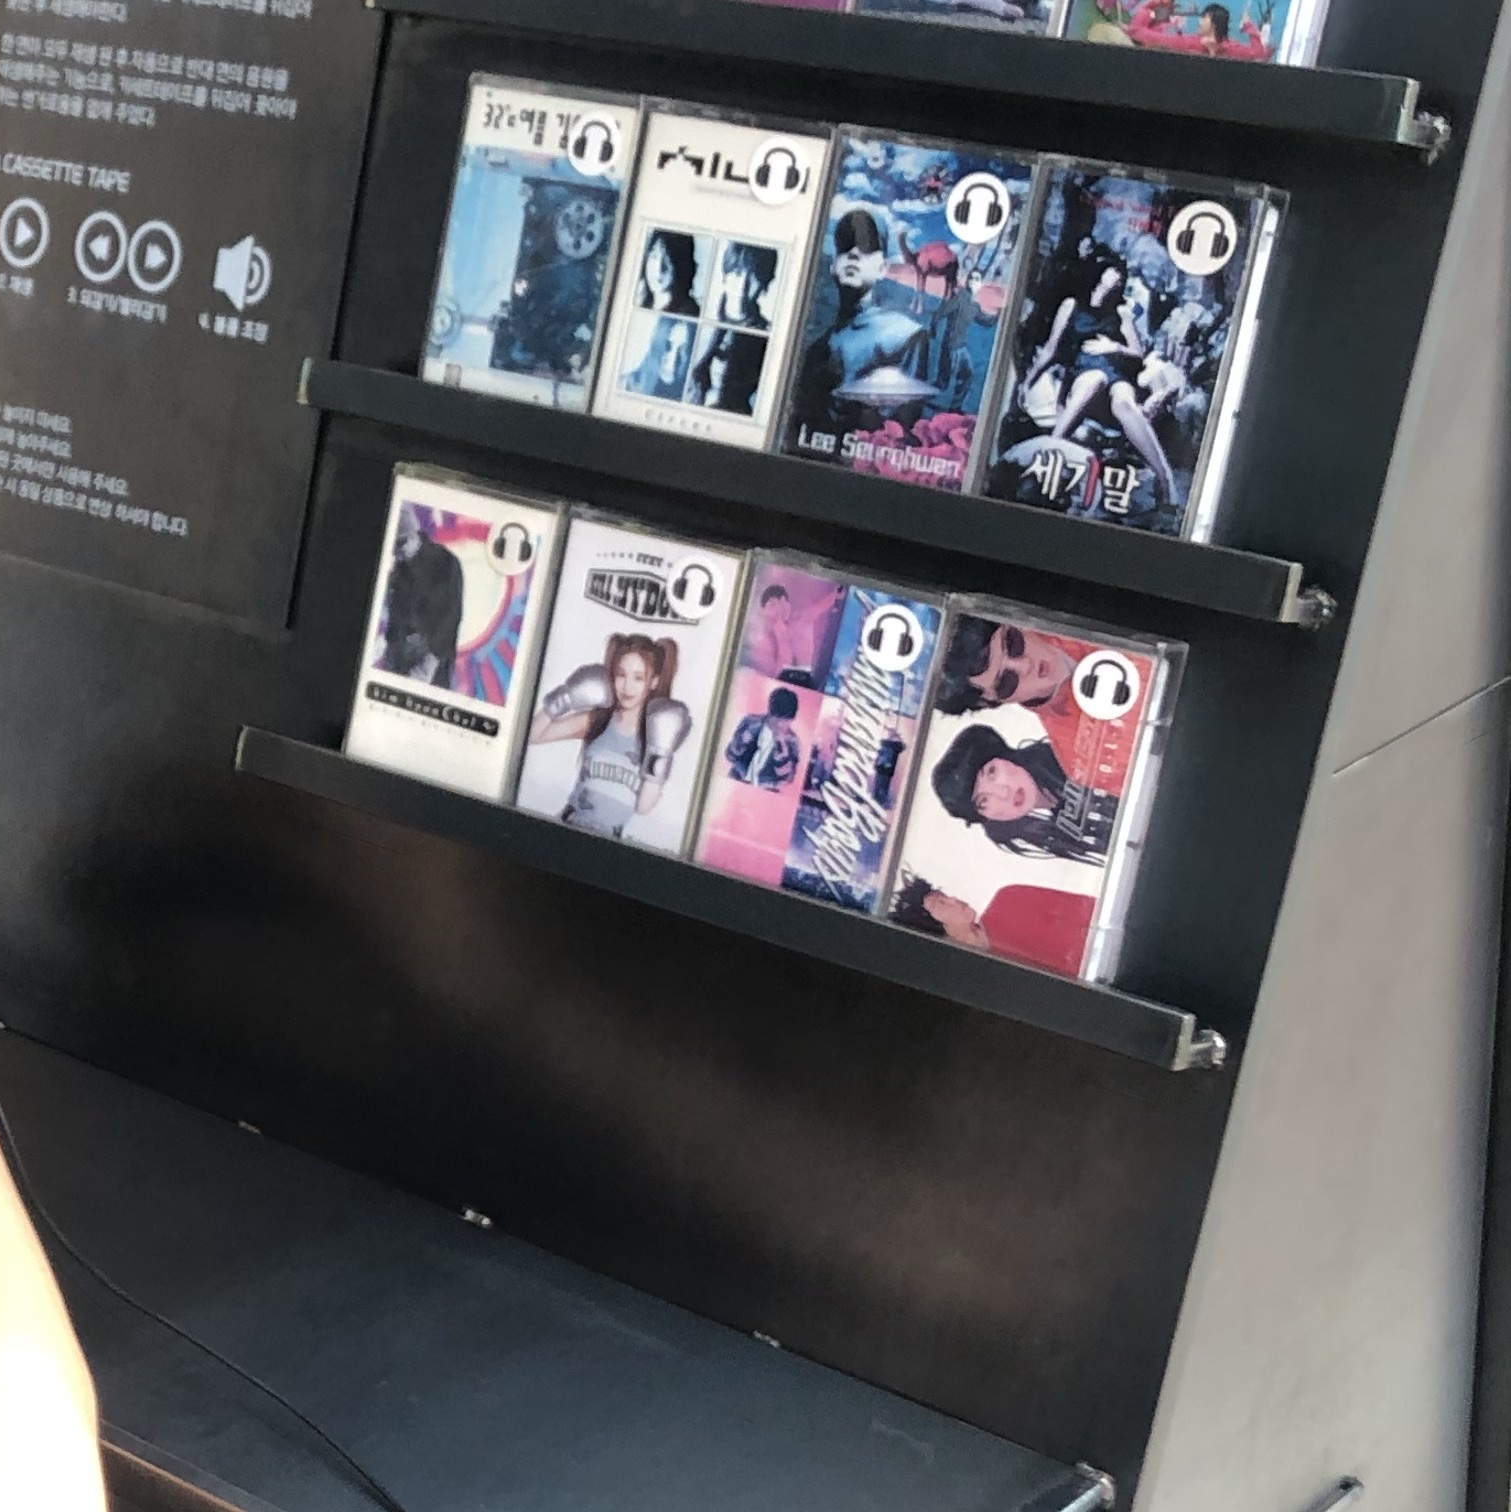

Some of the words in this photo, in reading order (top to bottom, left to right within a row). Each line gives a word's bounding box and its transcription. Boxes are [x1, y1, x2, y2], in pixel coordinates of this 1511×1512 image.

[3, 153, 85, 187] CASSETTE
[87, 166, 131, 194] TAPE
[798, 424, 834, 454] Lee
[1021, 448, 1140, 515] 세기말
